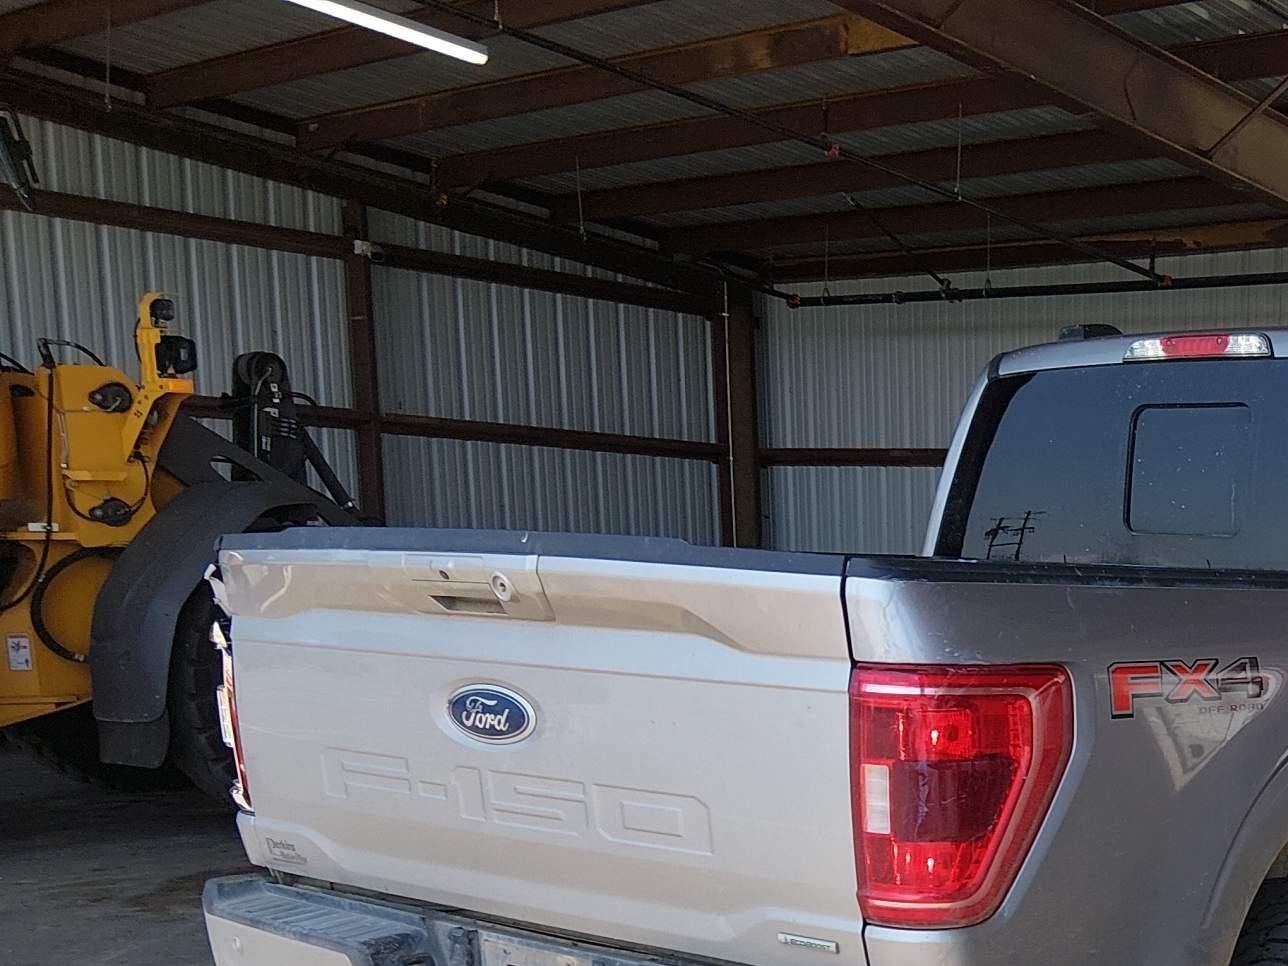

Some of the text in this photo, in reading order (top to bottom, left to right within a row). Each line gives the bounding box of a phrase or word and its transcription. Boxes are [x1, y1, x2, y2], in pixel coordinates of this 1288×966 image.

[461, 695, 510, 732] Ford
[1107, 657, 1264, 720] FX4
[1199, 704, 1225, 714] OFF
[320, 745, 714, 857] F-150
